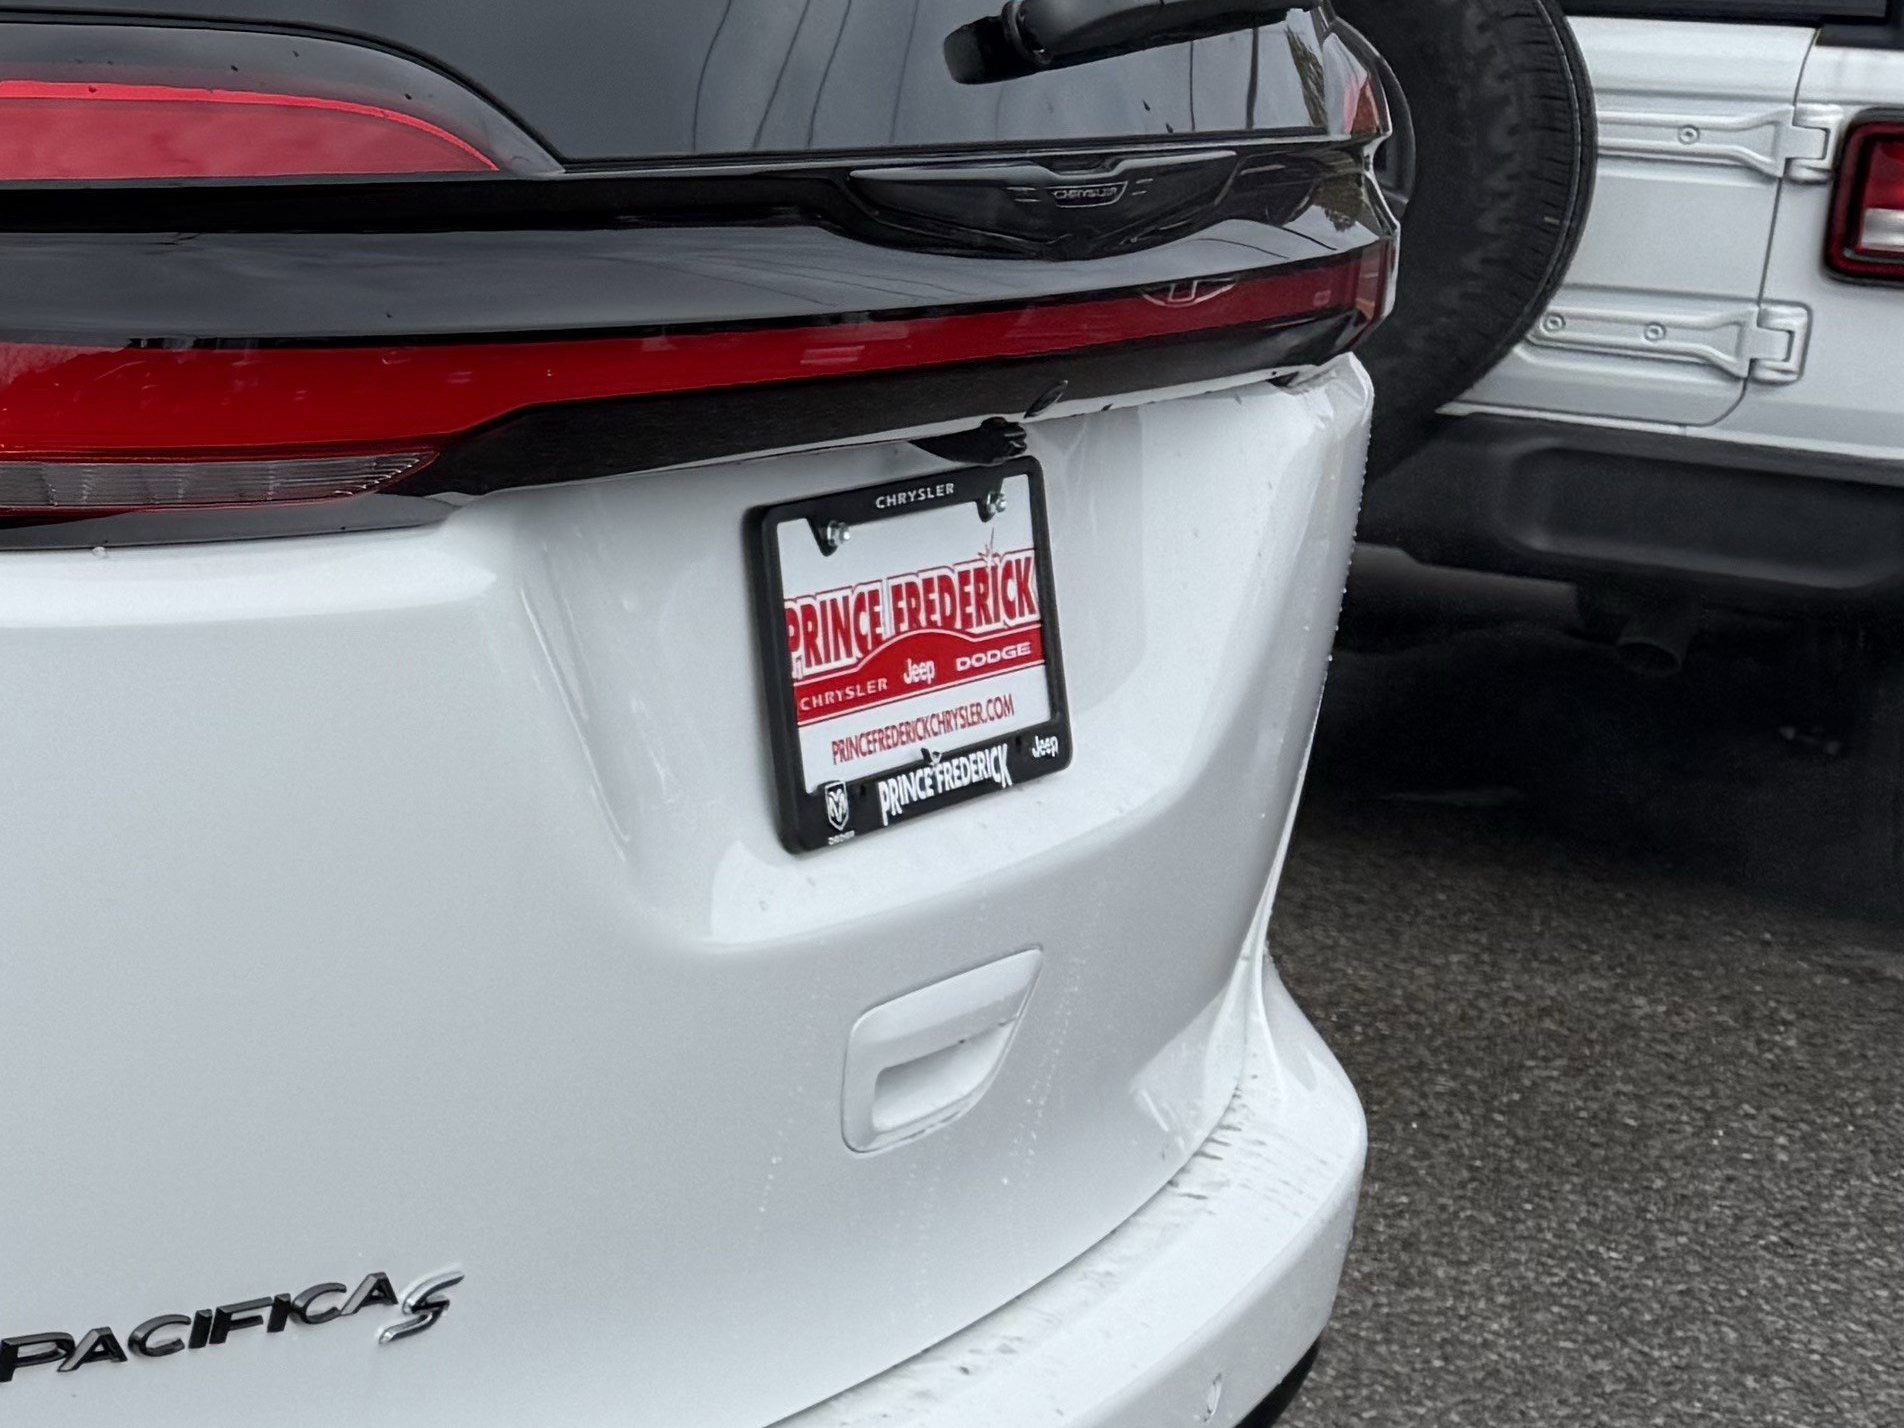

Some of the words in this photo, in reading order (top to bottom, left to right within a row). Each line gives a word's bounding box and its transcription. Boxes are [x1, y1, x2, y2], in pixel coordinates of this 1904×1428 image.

[875, 482, 955, 509] CHRYSLER
[785, 588, 883, 669] PRINCE
[890, 556, 1037, 633] FREDERICK
[799, 677, 888, 711] CHRYSLER
[903, 658, 935, 684] Jeep
[955, 641, 1032, 671] DODGE
[831, 693, 1015, 766] PRINCEFREDERICKCHRYSLER.COM
[1031, 735, 1059, 759] Jeep
[877, 767, 935, 826] PRINCE
[936, 742, 1013, 794] FREDERICK
[378, 1267, 465, 1344] S
